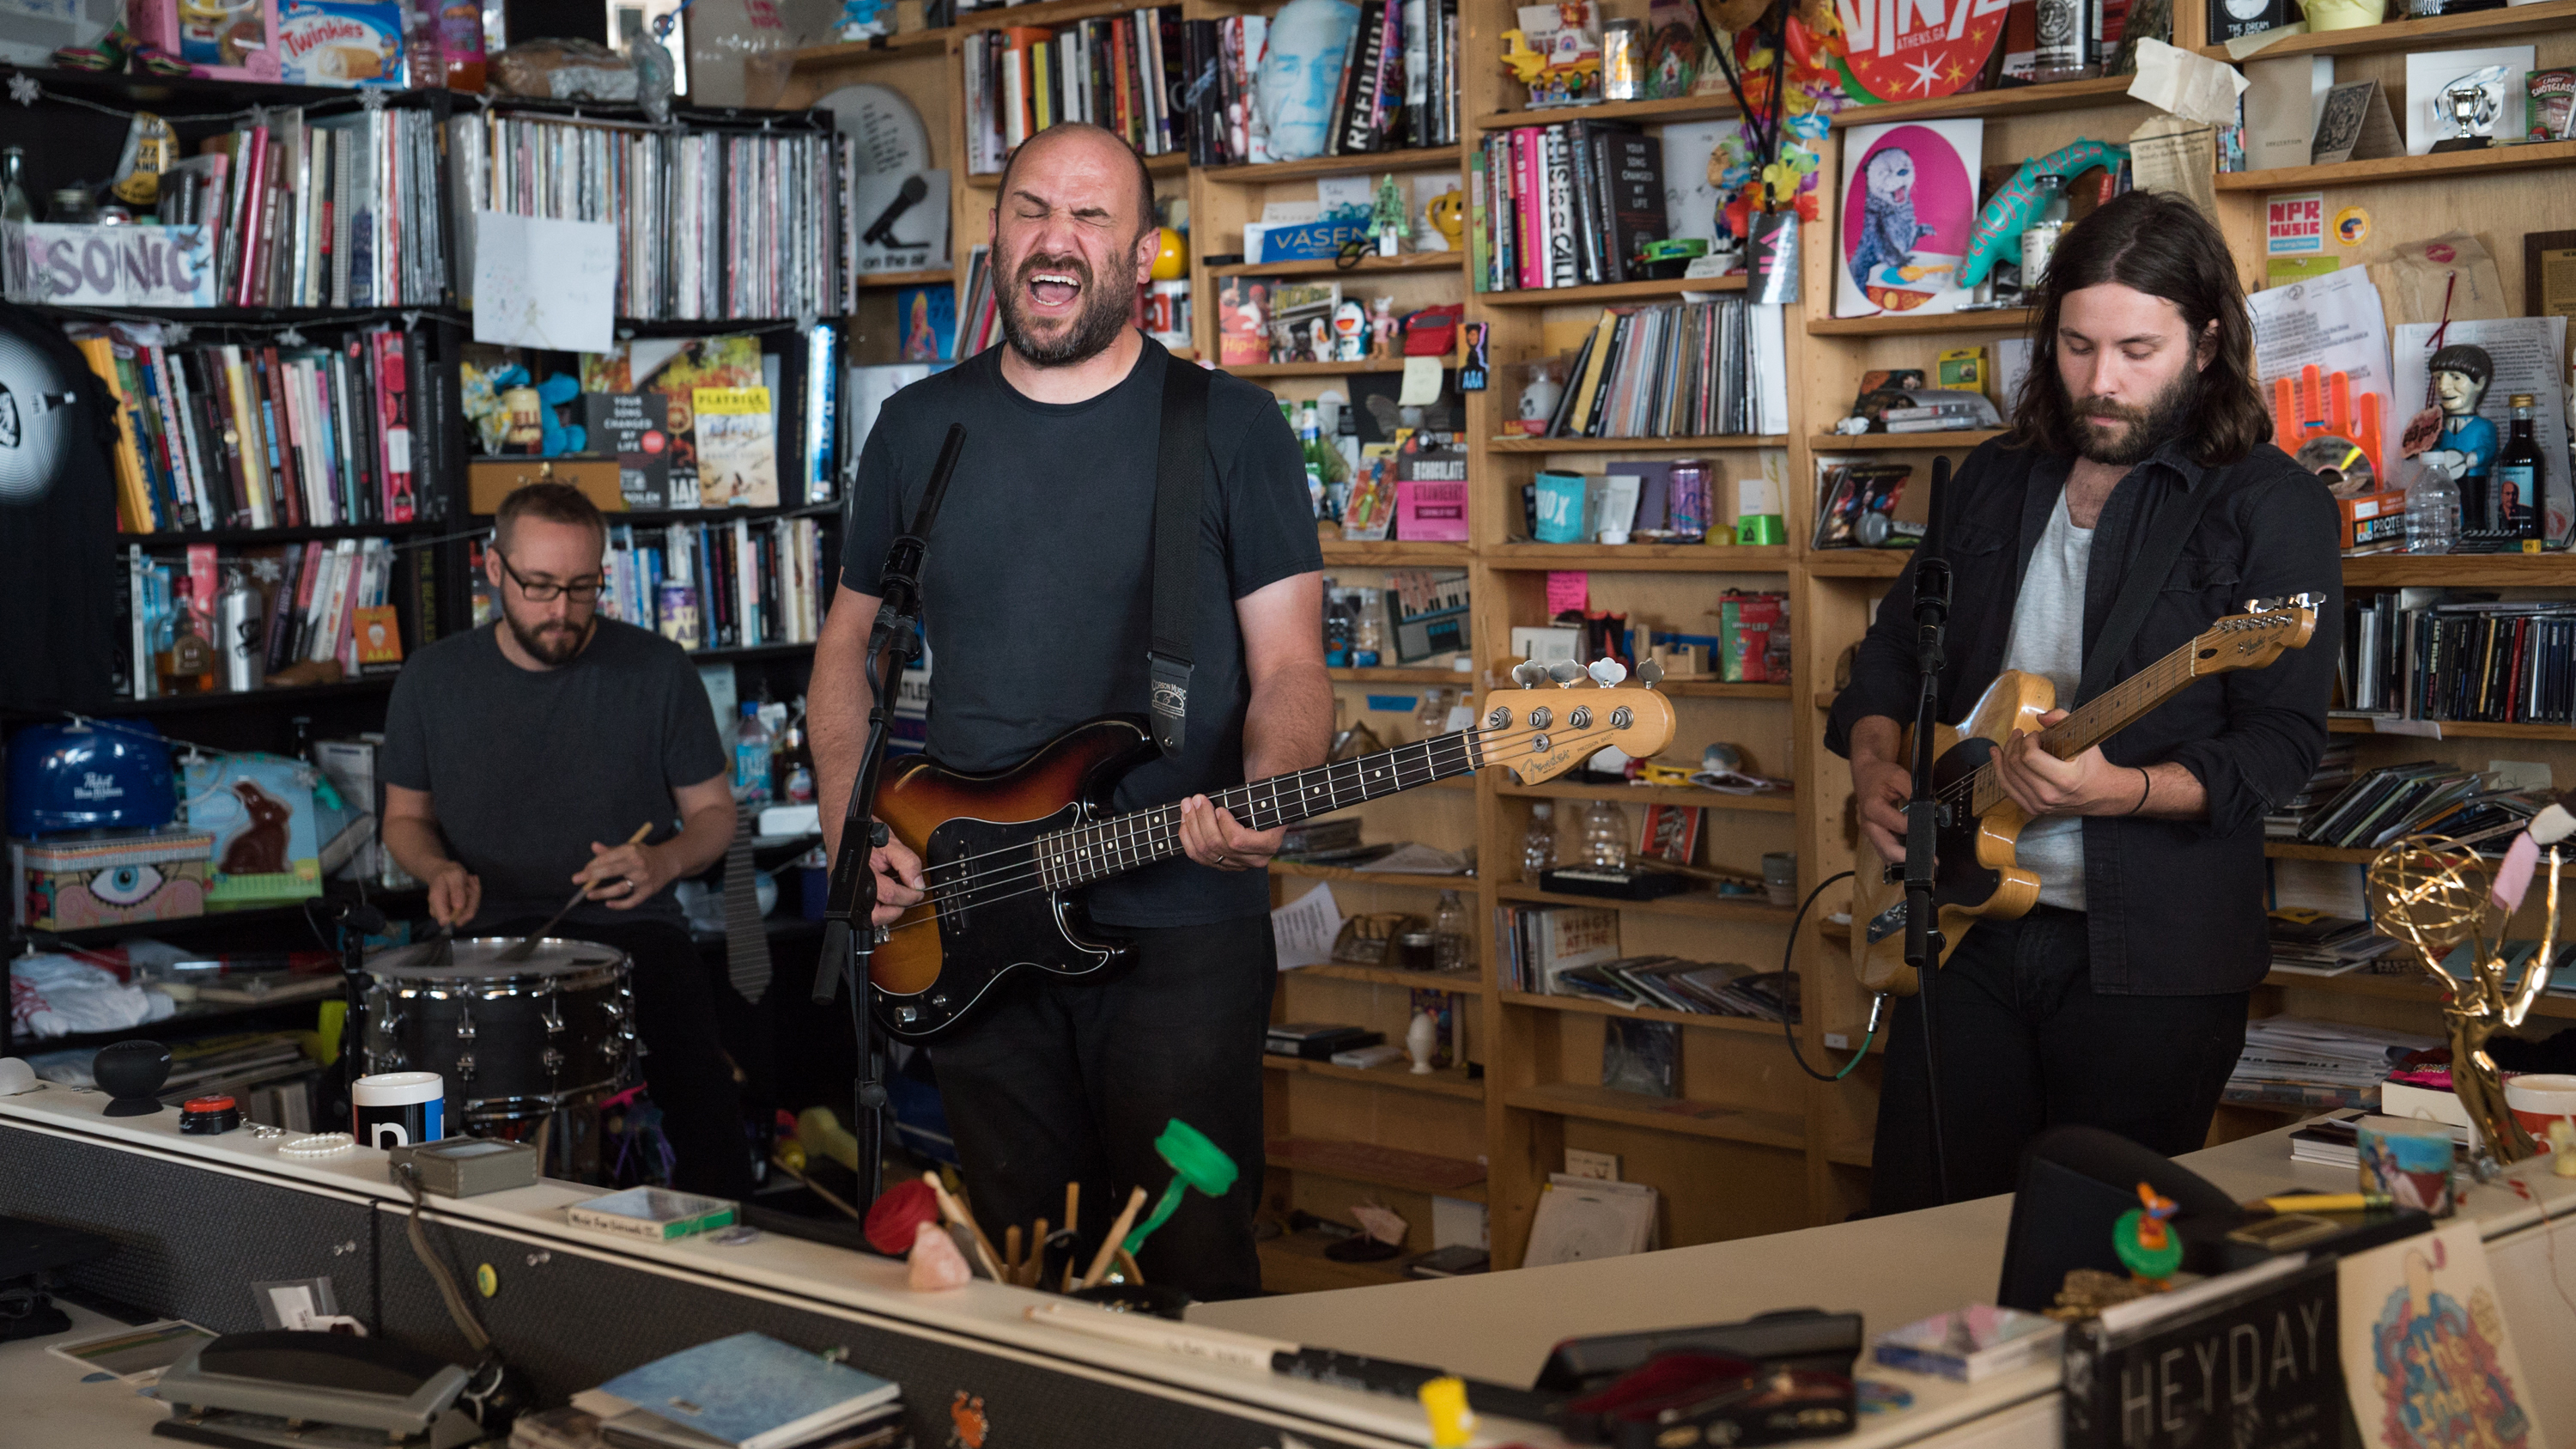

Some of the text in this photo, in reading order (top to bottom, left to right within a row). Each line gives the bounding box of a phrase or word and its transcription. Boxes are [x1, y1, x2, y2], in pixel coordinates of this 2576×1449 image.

[2227, 20, 2269, 33] THE DREAM
[280, 18, 364, 58] Twinkies
[2543, 76, 2565, 85] CANDY
[2269, 200, 2321, 223] NPR
[2269, 221, 2321, 238] MUSIC
[1275, 227, 1374, 250] VÄSEN
[862, 257, 881, 270] on
[884, 254, 907, 268] the
[614, 395, 642, 407] YOUR
[613, 406, 642, 419] SONG
[604, 417, 653, 430] CHANGED
[617, 441, 641, 453] LIFE
[2356, 530, 2373, 543] KIND
[1170, 683, 1187, 701] MUSIC
[1577, 740, 1600, 754] PRECISION
[1521, 746, 1571, 782] Fender
[2414, 1327, 2470, 1378] the
[2120, 1299, 2324, 1448] HEYDAY
